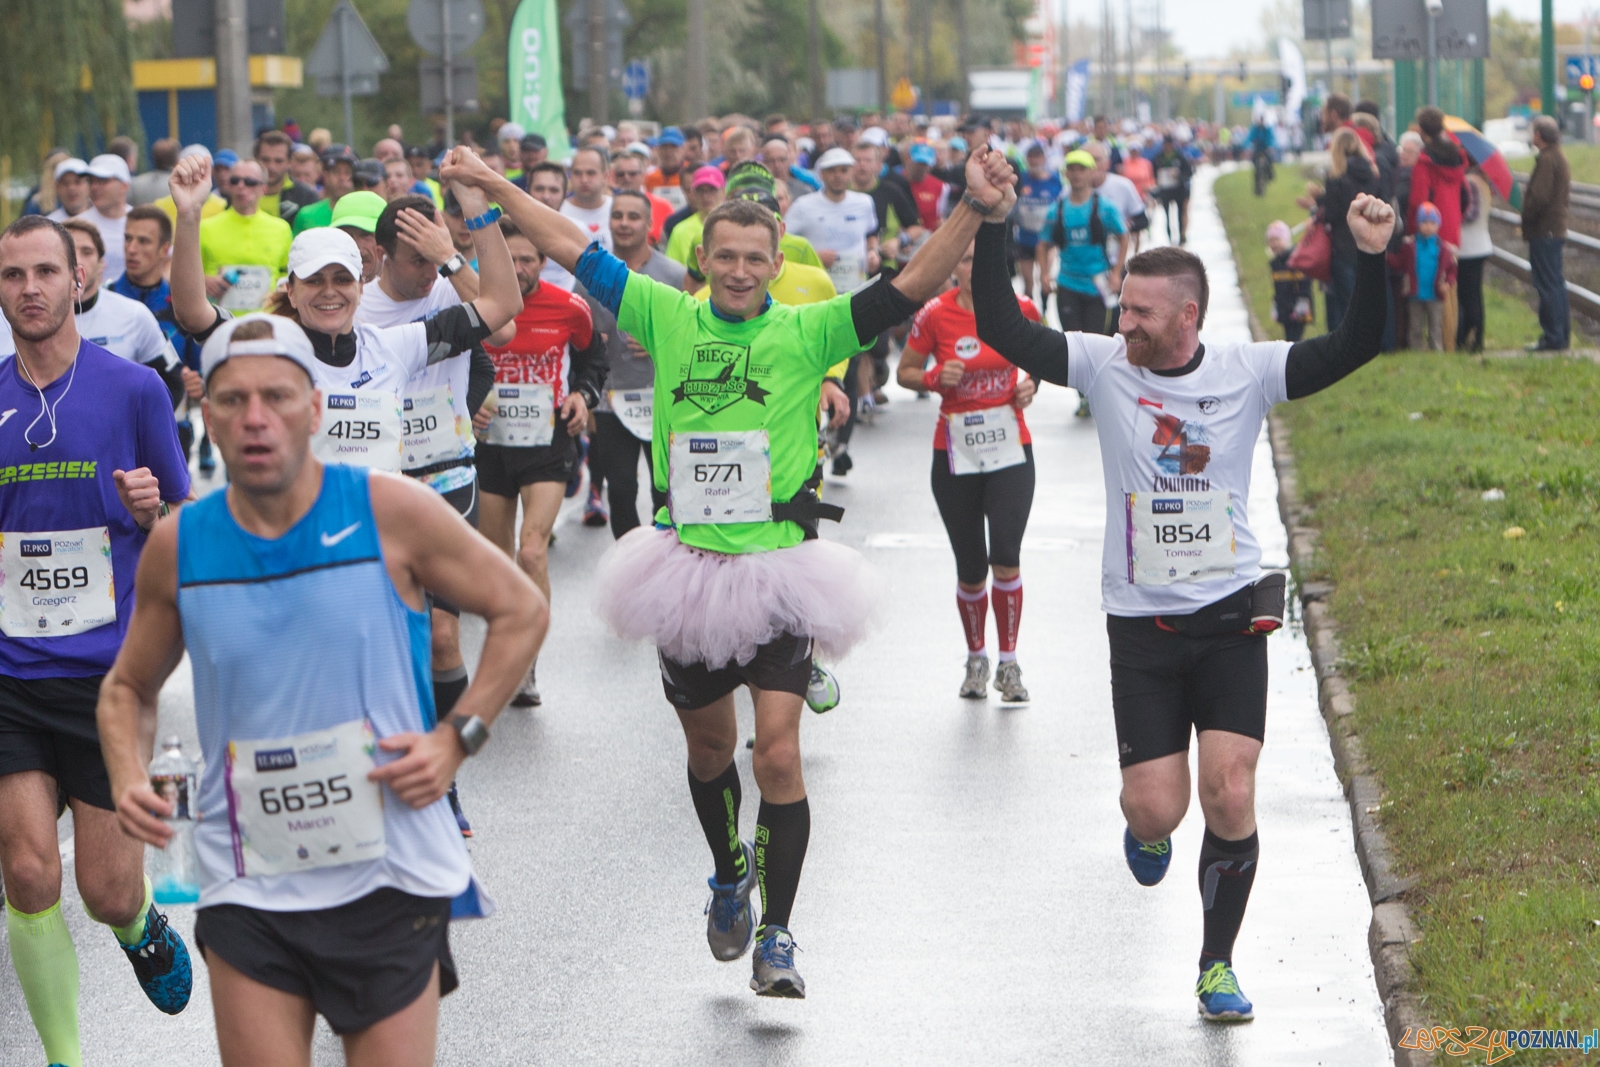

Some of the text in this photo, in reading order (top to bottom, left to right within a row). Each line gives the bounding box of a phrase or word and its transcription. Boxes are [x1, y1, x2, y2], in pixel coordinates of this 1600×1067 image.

[522, 27, 541, 121] 4:00
[749, 366, 772, 375] MNIE
[330, 397, 355, 406] 17.PKO
[498, 404, 540, 419] 6035
[328, 420, 381, 440] 4135
[404, 437, 431, 447] Robert
[965, 428, 1007, 447] 6033
[336, 444, 369, 453] Joanna
[692, 441, 716, 450] 17.PKO
[694, 464, 742, 482] 6771
[704, 488, 730, 496] Rafał
[1155, 502, 1181, 511] 17.PKO
[1153, 523, 1212, 544] 1854
[23, 544, 49, 553] 17.PKO
[1164, 549, 1203, 558] Tomasz
[20, 566, 89, 591] 4569
[32, 595, 77, 607] Grzegorz
[259, 774, 353, 815] 6635
[287, 815, 335, 832] Marcin
[755, 845, 766, 868] SKIN
